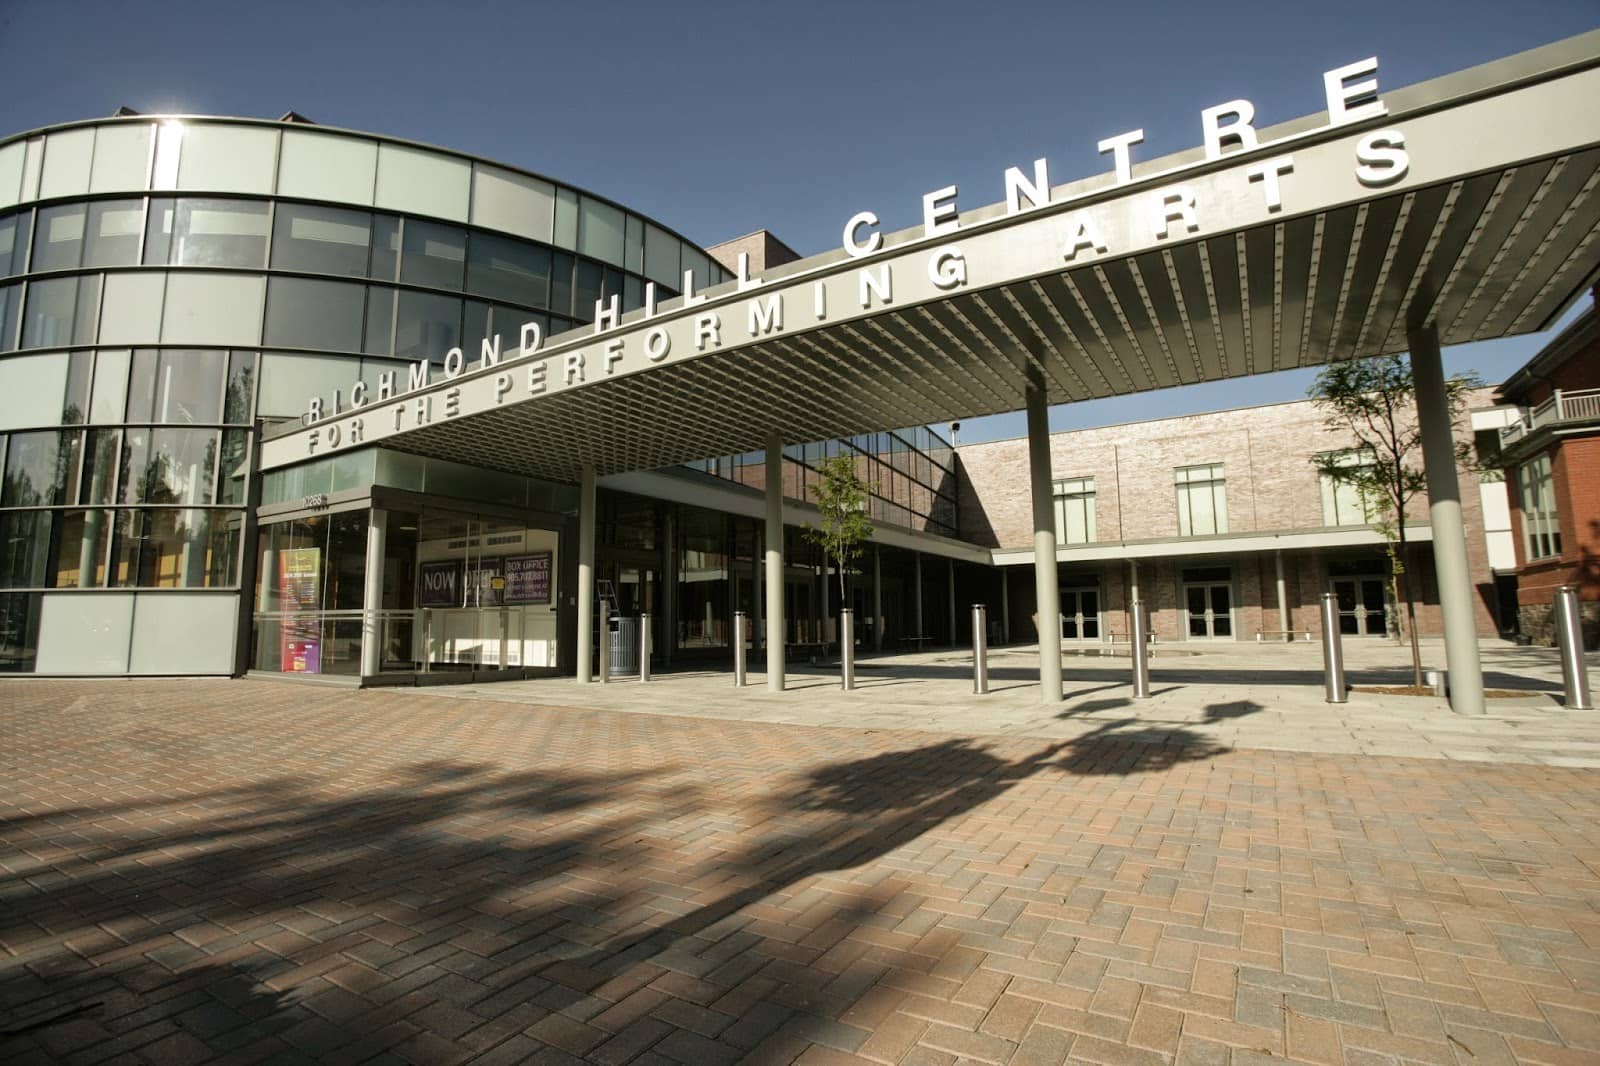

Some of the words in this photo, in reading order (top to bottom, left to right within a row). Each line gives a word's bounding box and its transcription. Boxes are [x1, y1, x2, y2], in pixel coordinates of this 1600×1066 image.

[308, 321, 542, 425] RICHMOND
[594, 252, 762, 333] HILL
[843, 56, 1389, 258] CENTRE
[308, 417, 365, 455] FOR
[392, 387, 460, 431] THE
[493, 245, 968, 404] PERFORMING
[1063, 130, 1410, 262] ARTS
[424, 570, 456, 592] NOW
[523, 559, 549, 570] OFFICE
